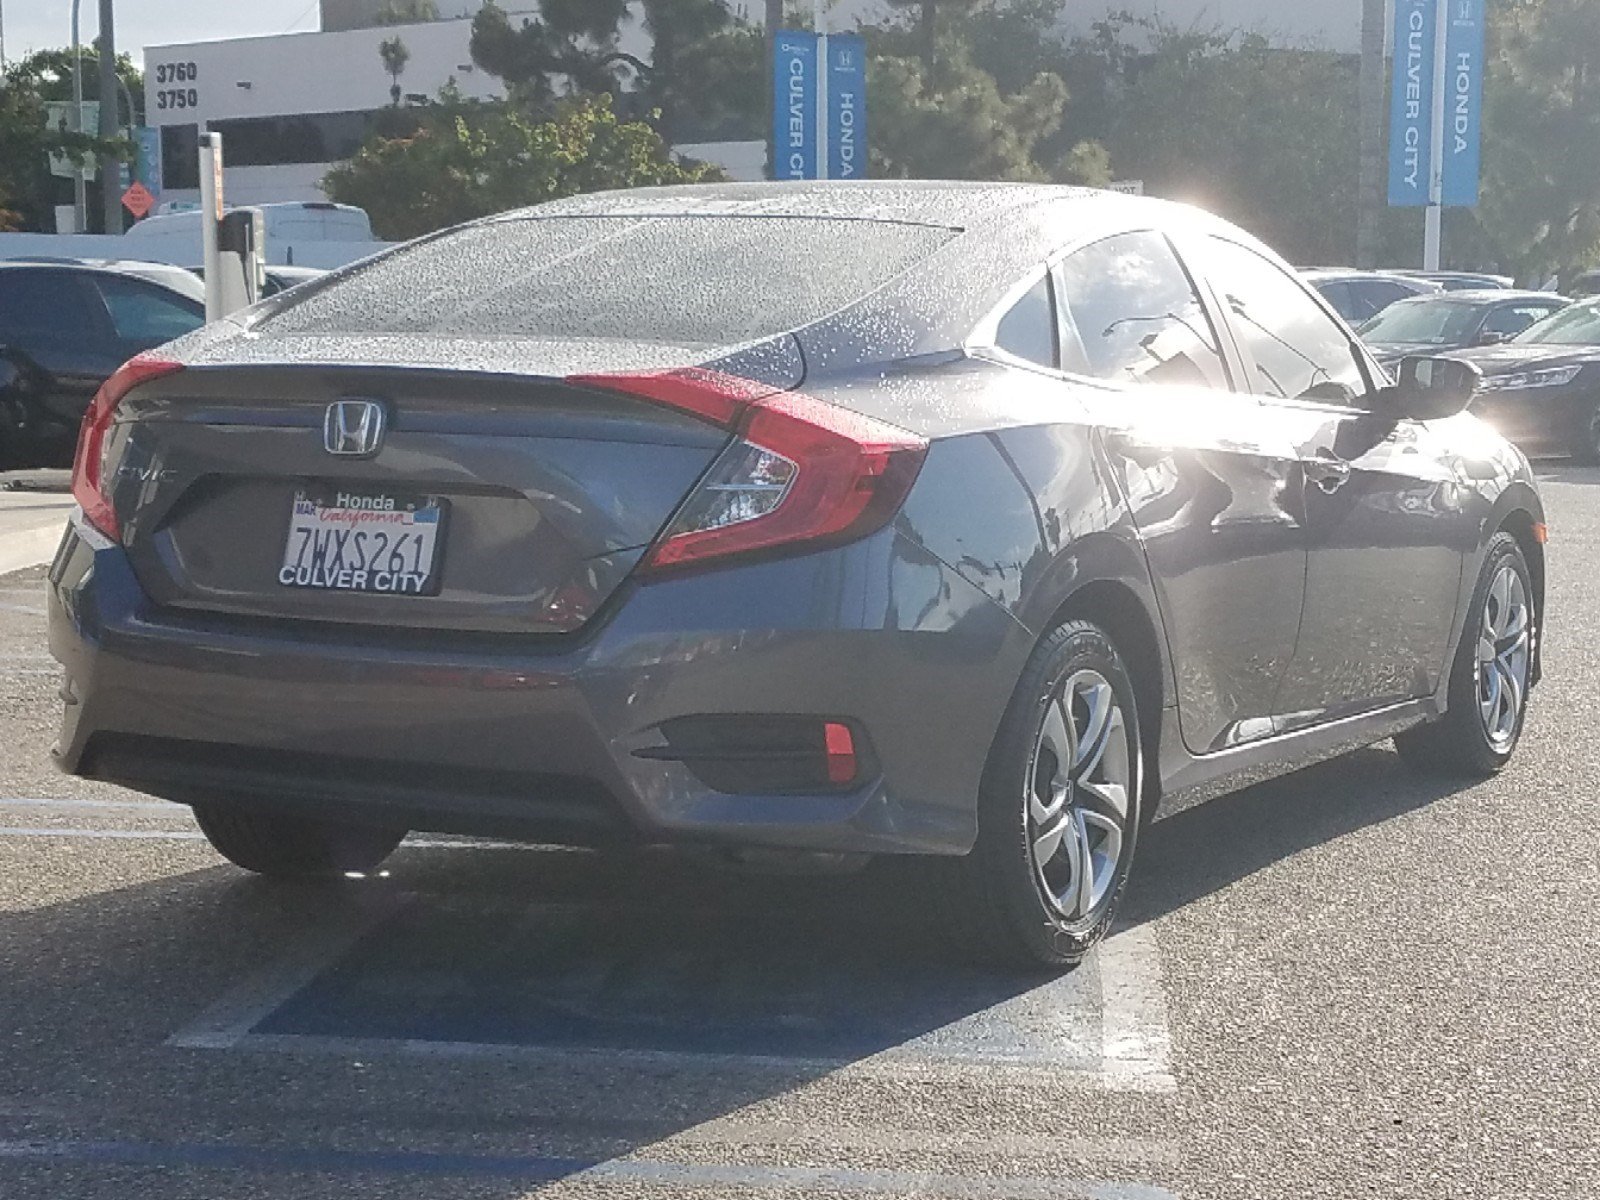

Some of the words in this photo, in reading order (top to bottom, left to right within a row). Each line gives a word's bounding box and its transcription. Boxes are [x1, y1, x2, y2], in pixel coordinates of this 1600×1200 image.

[156, 62, 197, 83] 3760
[1405, 11, 1423, 119] CULVER
[157, 88, 198, 109] 3750
[789, 58, 804, 148] CULVER
[1454, 53, 1470, 154] HONDA
[840, 93, 854, 177] HONDA
[789, 152, 804, 180] CI
[1404, 126, 1419, 190] CITY
[319, 507, 405, 528] California
[336, 492, 395, 510] Honda
[296, 527, 424, 575] 7WXS261
[278, 566, 368, 590] CULVER
[374, 572, 429, 592] CITY
